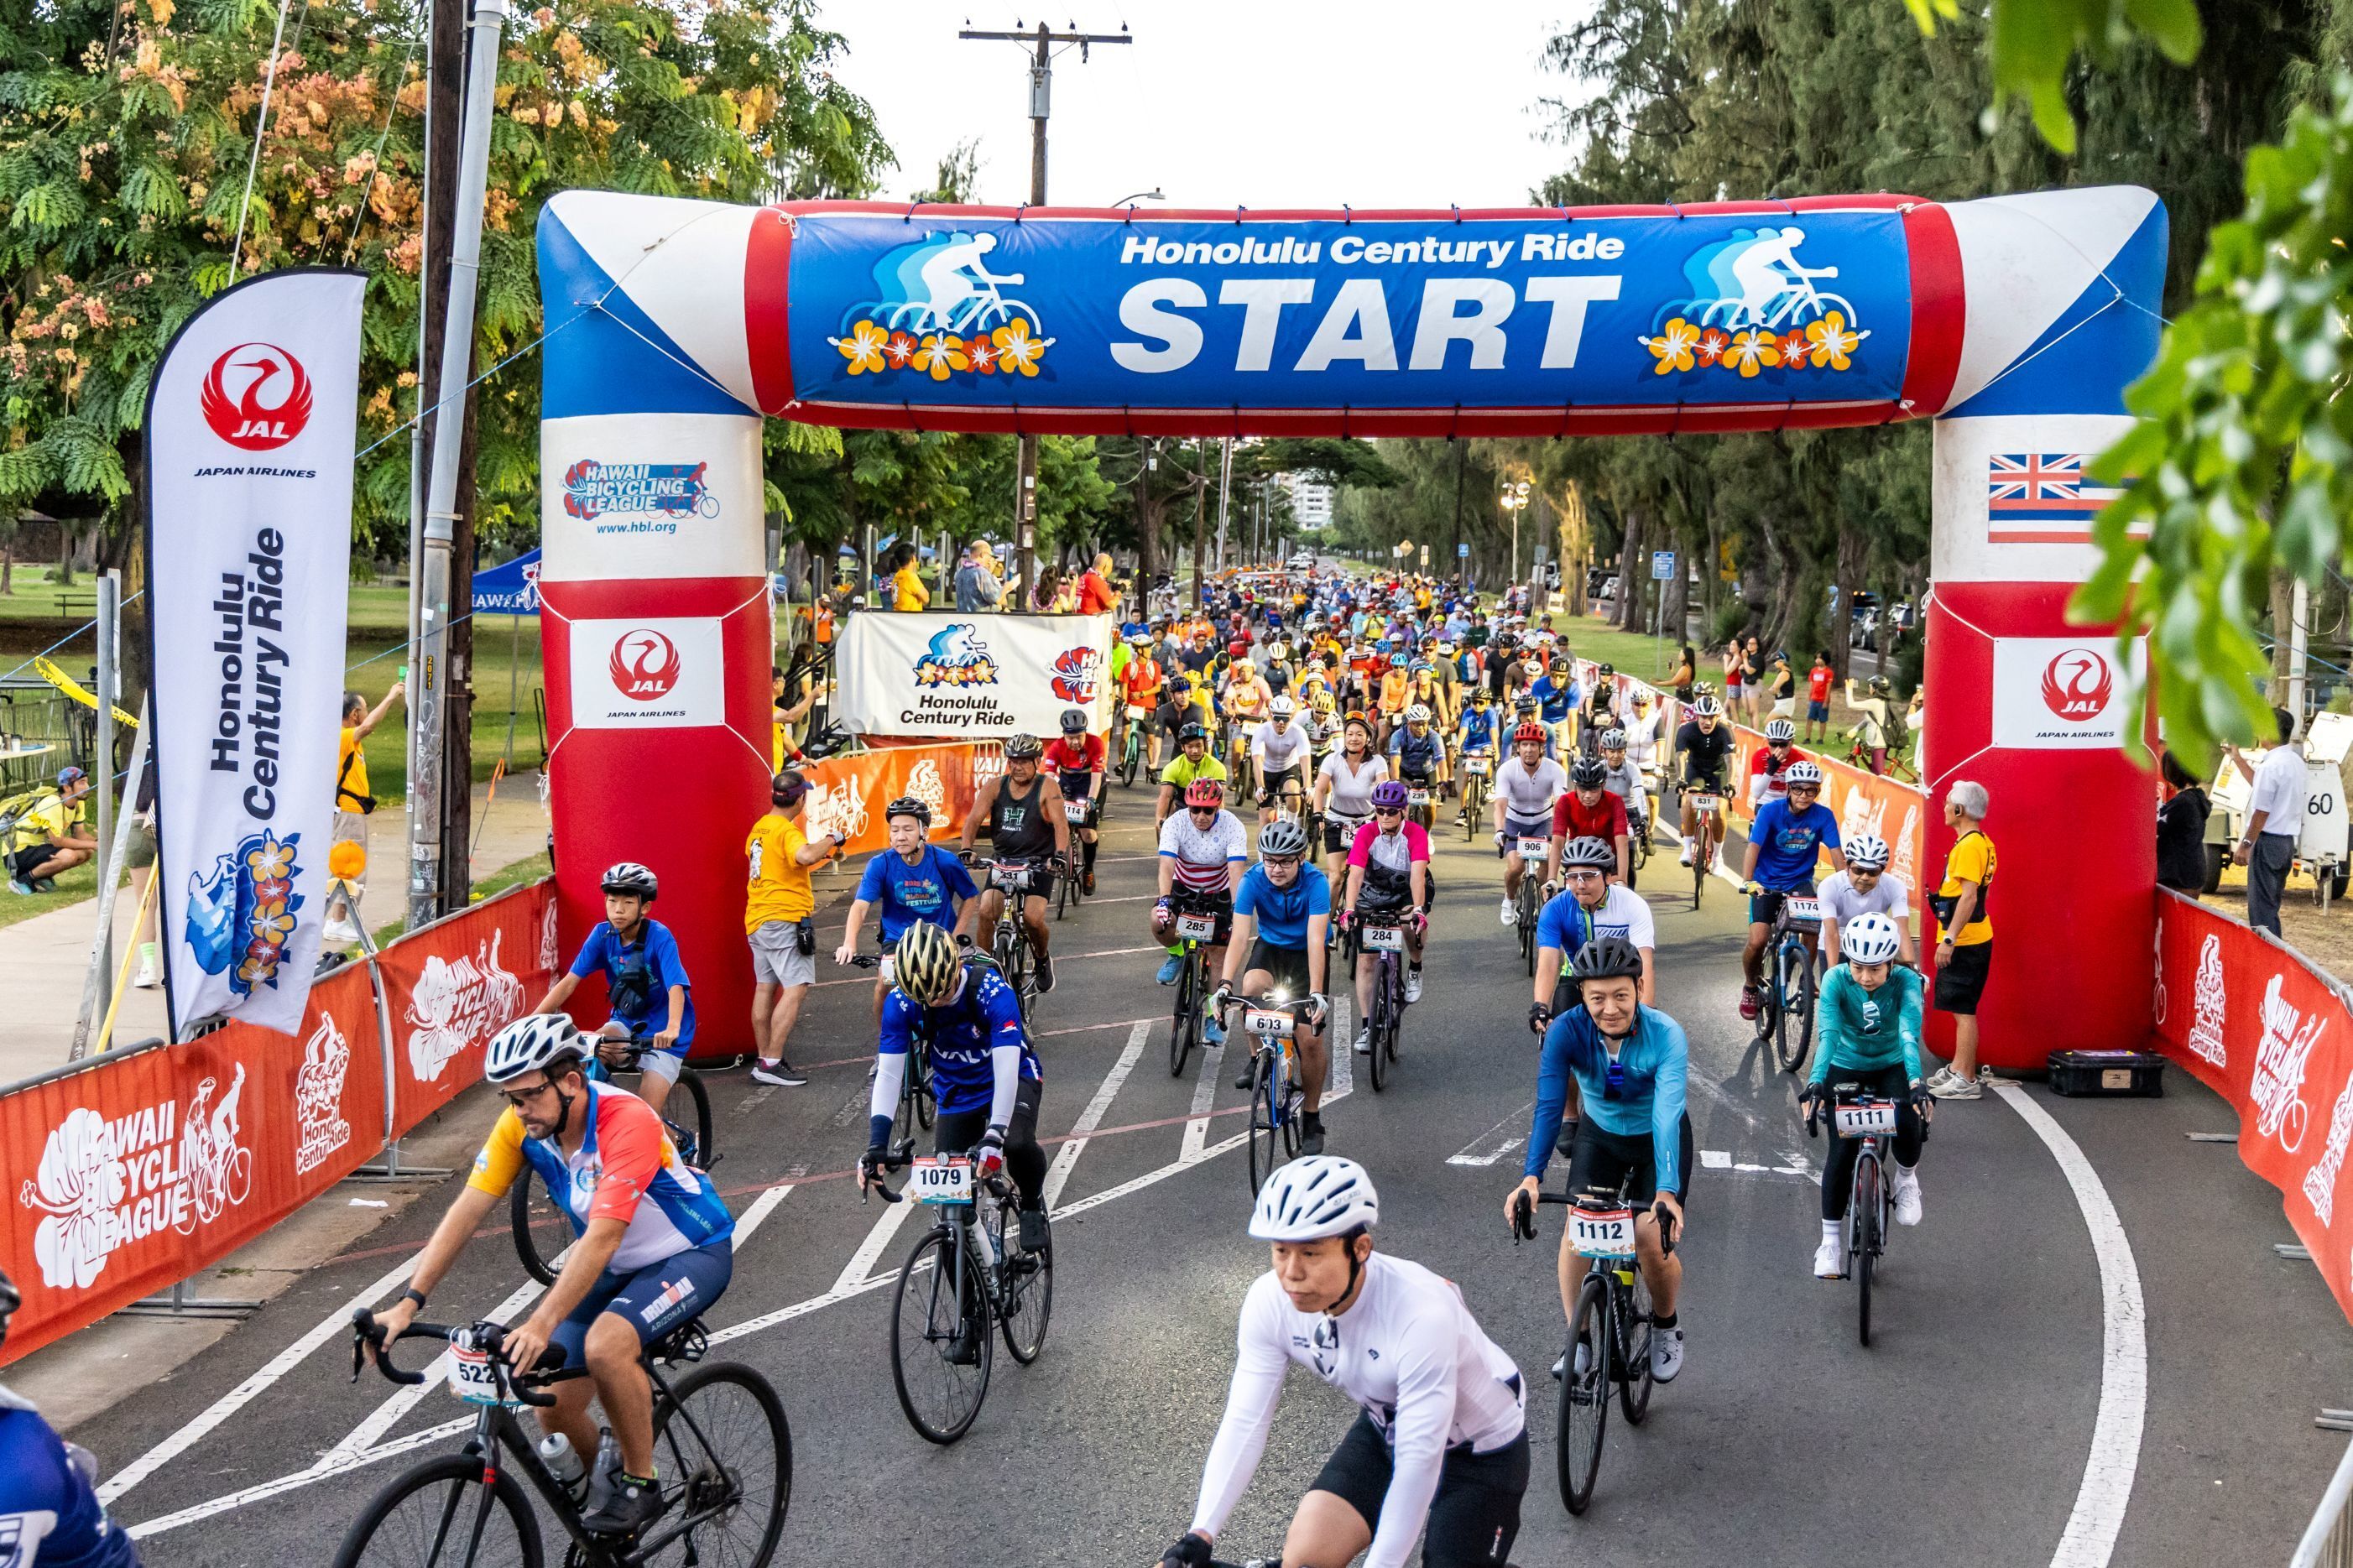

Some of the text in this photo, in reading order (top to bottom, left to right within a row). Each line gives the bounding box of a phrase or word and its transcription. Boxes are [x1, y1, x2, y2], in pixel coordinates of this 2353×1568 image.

[1119, 233, 1625, 269] Honolulu Century Ride
[1110, 274, 1622, 373] START
[231, 419, 290, 439] JAL
[194, 466, 316, 479] JAPAN AIRLINES
[585, 464, 651, 482] HAWAII
[586, 479, 685, 497] BICYCLING
[587, 495, 657, 513] LEAGUE
[597, 521, 676, 534] www.hbl.org
[210, 572, 245, 773] Honolulu
[243, 527, 290, 820] Century Ride
[628, 680, 667, 692] JAL
[920, 695, 998, 710] Honolulu
[2060, 701, 2100, 712] JAL
[900, 710, 1015, 727] Century Ride
[1698, 797, 1711, 805] 831
[2308, 793, 2333, 815] 60
[931, 816, 949, 827] Ride
[1344, 831, 1355, 841] 12
[1524, 842, 1541, 851] 906
[906, 898, 942, 907] FESTIVAL
[1794, 901, 1819, 911] 1174
[1186, 920, 1206, 932] 285
[1371, 930, 1392, 941] 284
[1256, 1018, 1281, 1030] 603
[1844, 1110, 1884, 1126] 1111
[329, 1123, 350, 1149] Ride
[921, 1169, 962, 1185] 1079
[1578, 1221, 1623, 1240] 1112
[640, 1276, 696, 1324] IRONMAN
[651, 1306, 682, 1332] ARIZONA
[458, 1362, 497, 1384] 522
